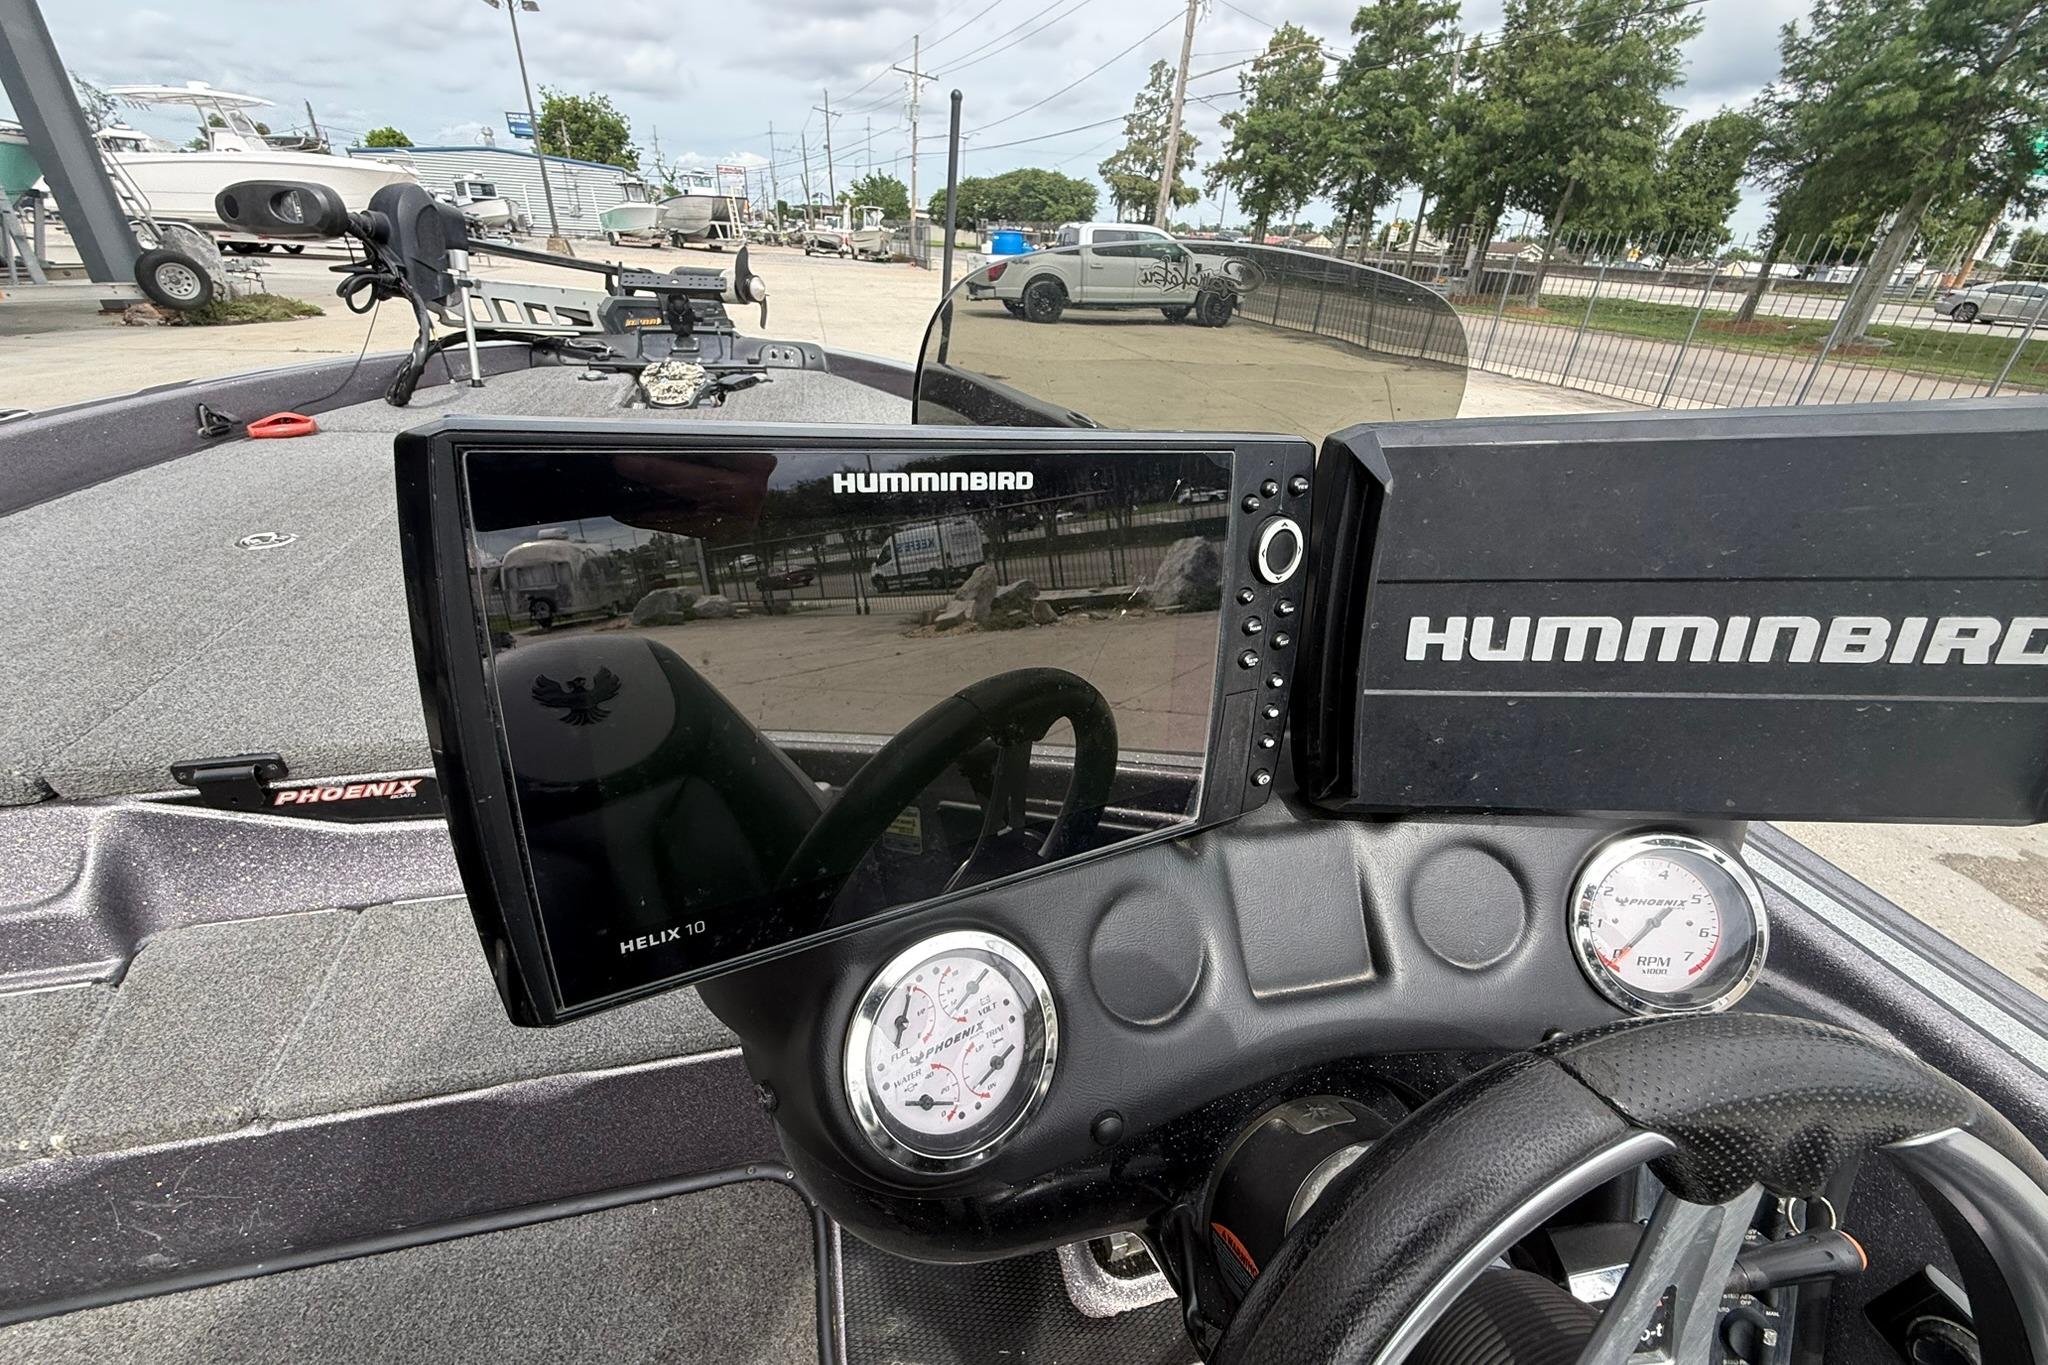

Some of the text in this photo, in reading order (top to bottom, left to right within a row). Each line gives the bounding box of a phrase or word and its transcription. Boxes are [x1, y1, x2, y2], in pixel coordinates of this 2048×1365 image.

[833, 472, 1034, 493] HUMMINBIRD
[1405, 616, 2048, 666] HUMMINBIRD
[273, 779, 423, 806] PHOENIX
[1658, 870, 1670, 880] 4
[1603, 886, 1615, 897] 2
[1691, 894, 1703, 904] 5
[1628, 898, 1688, 908] PHOENIX
[1597, 918, 1603, 928] 1
[620, 920, 706, 954] HELIX 10
[1699, 928, 1710, 938] 6
[1637, 956, 1671, 967] RPM
[1684, 951, 1695, 962] 7
[978, 1001, 998, 1016] VOLT
[985, 1024, 1005, 1039] TRIM
[925, 1020, 984, 1059] PHOENIX
[891, 1047, 911, 1062] FUEL
[893, 1067, 922, 1089] WATER
